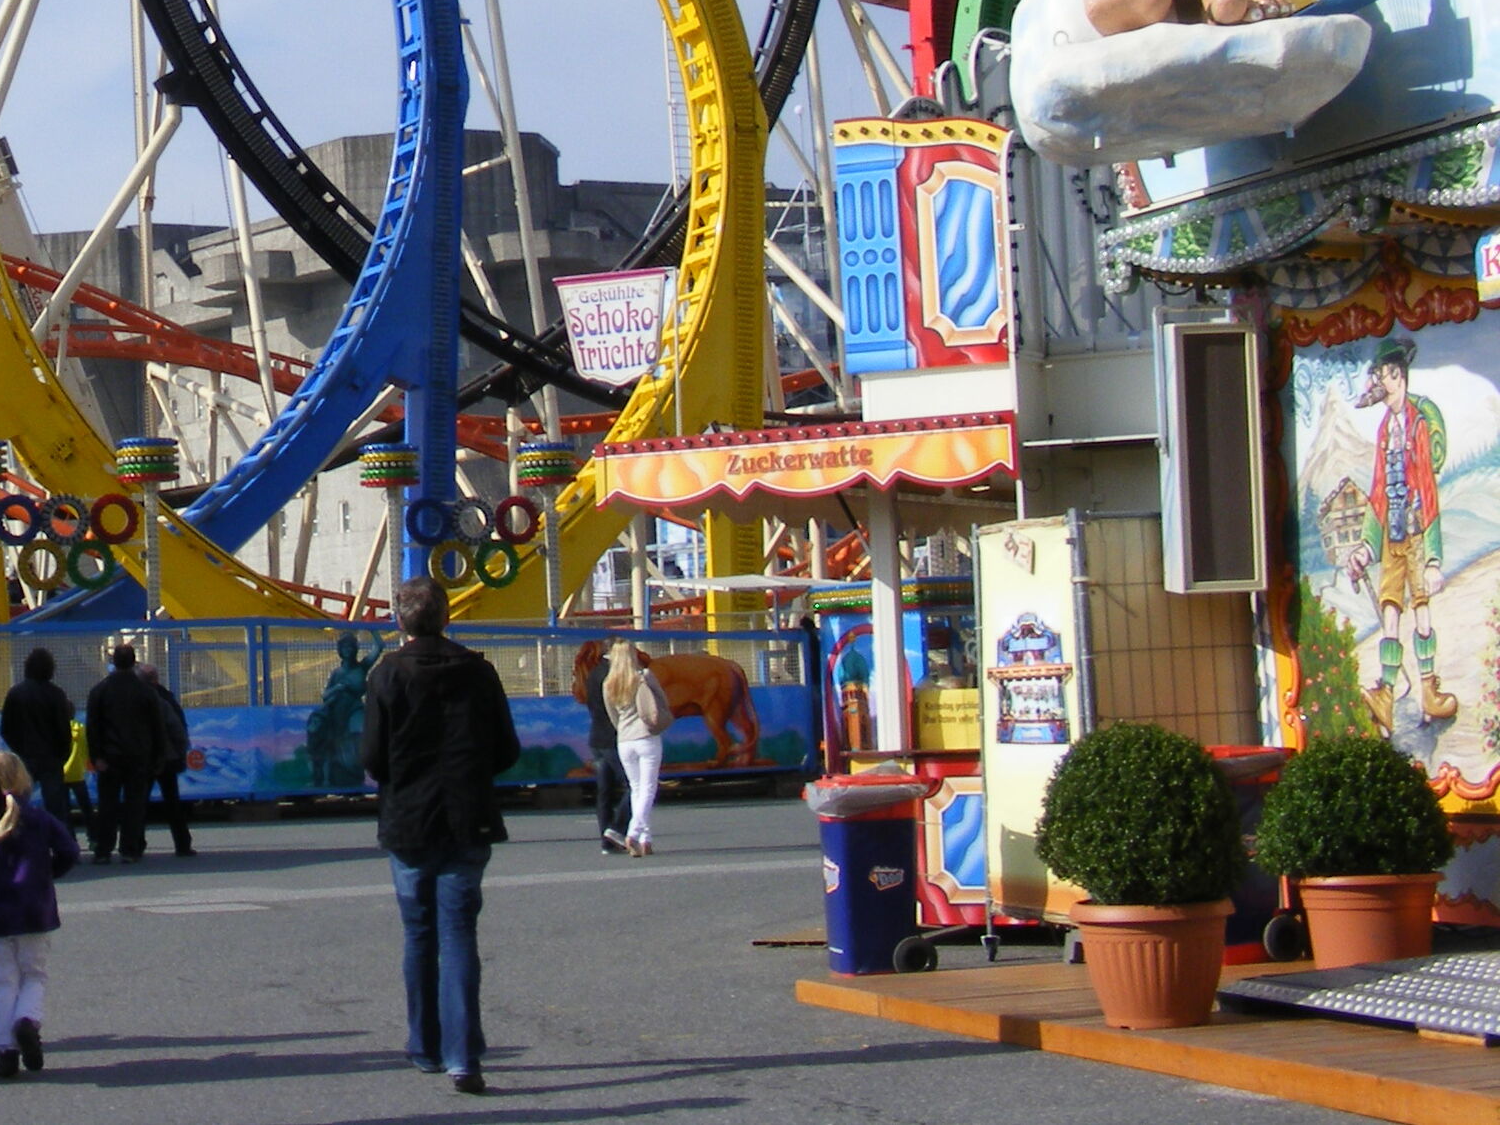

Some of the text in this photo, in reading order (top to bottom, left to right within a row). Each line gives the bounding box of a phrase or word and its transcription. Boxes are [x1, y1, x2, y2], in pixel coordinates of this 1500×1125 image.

[578, 285, 645, 304] Gekühlte
[568, 300, 660, 338] Schoko-
[576, 335, 658, 371] früchte
[727, 444, 874, 476] Zuckerwatte
